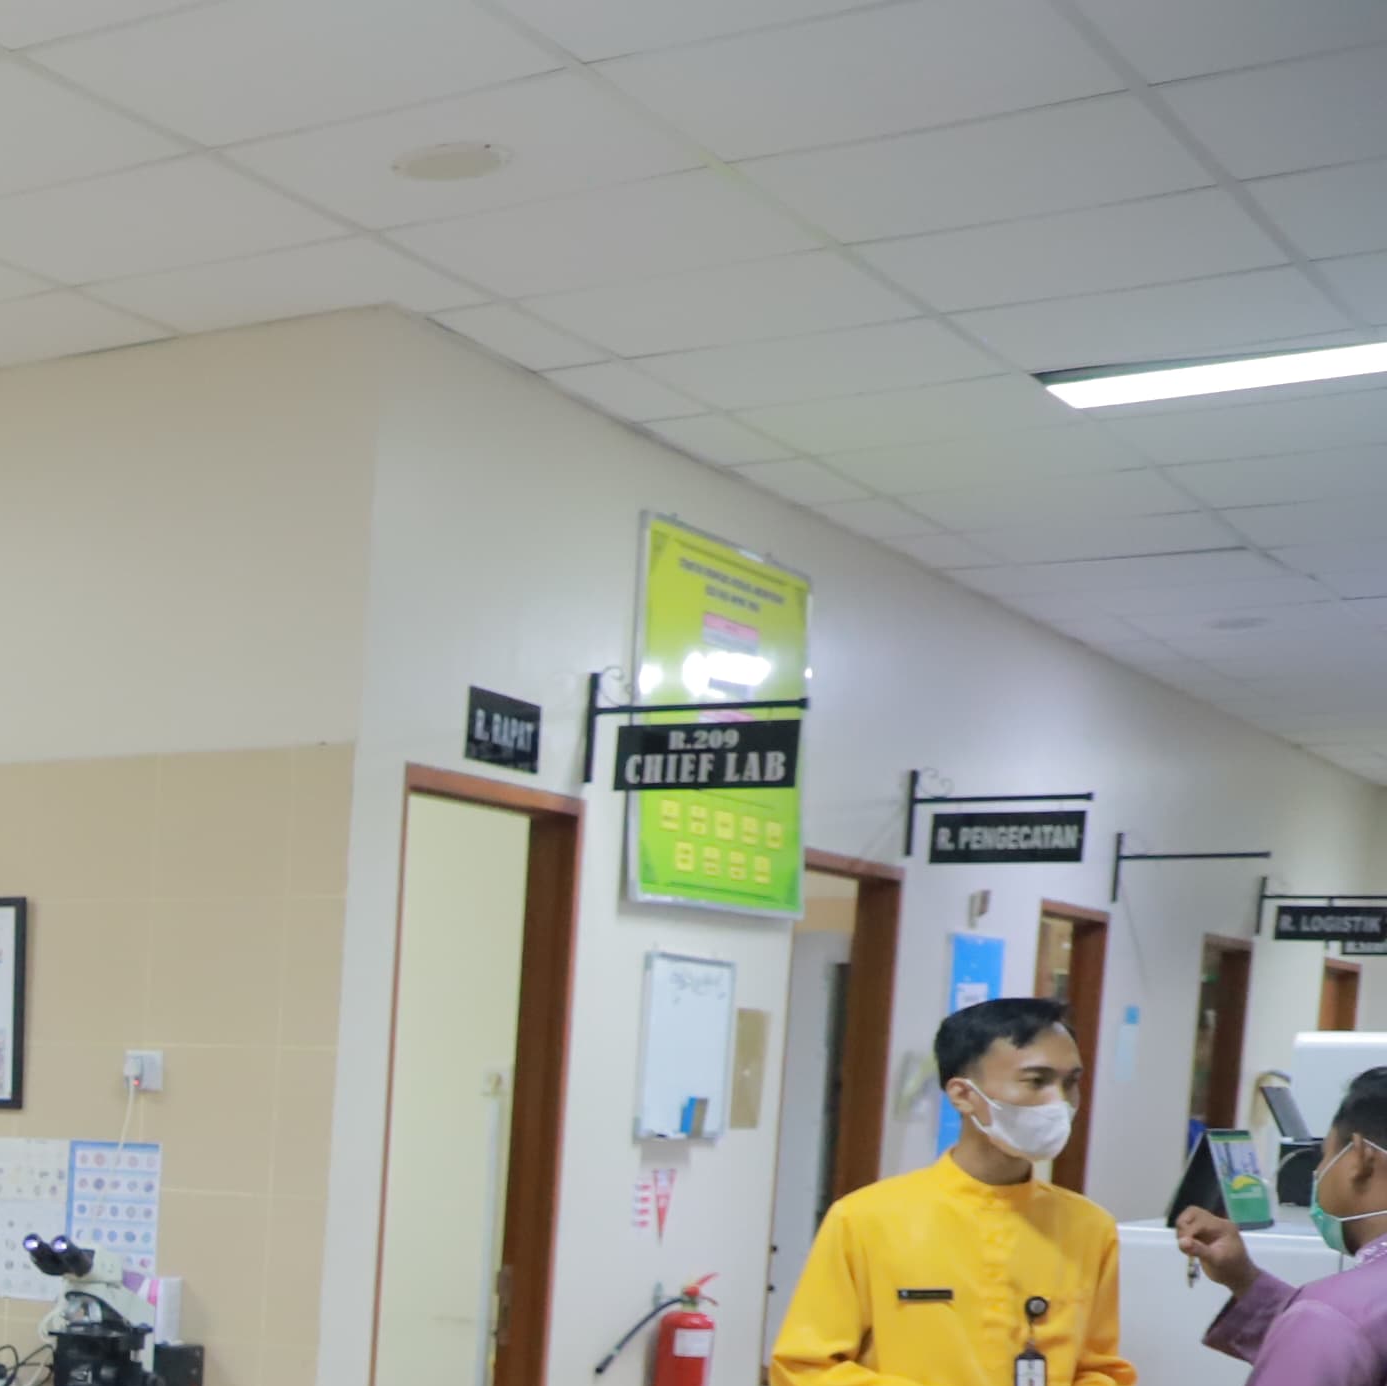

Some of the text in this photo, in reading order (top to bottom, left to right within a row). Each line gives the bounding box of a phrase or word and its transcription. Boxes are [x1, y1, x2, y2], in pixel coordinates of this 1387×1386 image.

[668, 728, 740, 751] R.209
[624, 750, 787, 785] CHIEF LAB
[936, 824, 1080, 851] R. PENGECATAN
[1300, 914, 1383, 933] LOGISTIK
